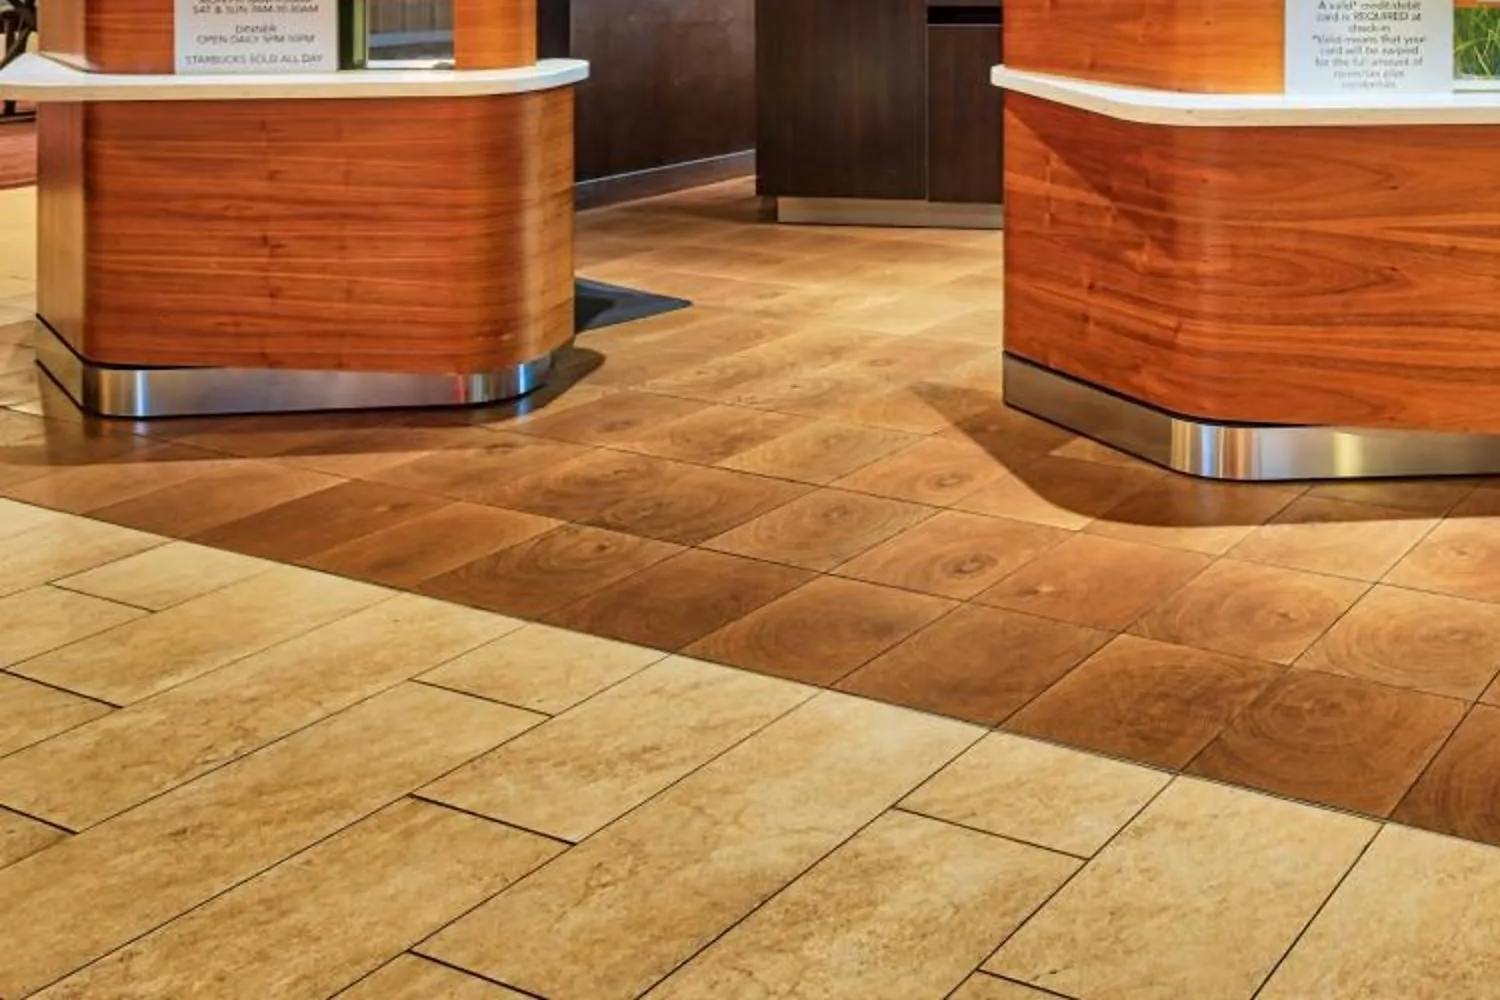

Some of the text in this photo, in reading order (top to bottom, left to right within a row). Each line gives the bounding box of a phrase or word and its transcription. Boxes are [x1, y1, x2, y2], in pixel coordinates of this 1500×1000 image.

[192, 4, 211, 14] SAT
[225, 4, 248, 14] SUN
[1317, 0, 1326, 9] A
[1316, 10, 1339, 22] card
[1353, 11, 1409, 22] REQUIRED
[1411, 11, 1422, 21] at
[235, 24, 277, 34] DINNER
[196, 34, 228, 45] OPEN
[230, 34, 259, 44] DAILY
[1381, 34, 1401, 44] that
[1404, 36, 1427, 46] your
[1365, 46, 1379, 55] be
[185, 53, 324, 64] STARBUCKS SOLD ALL DAY
